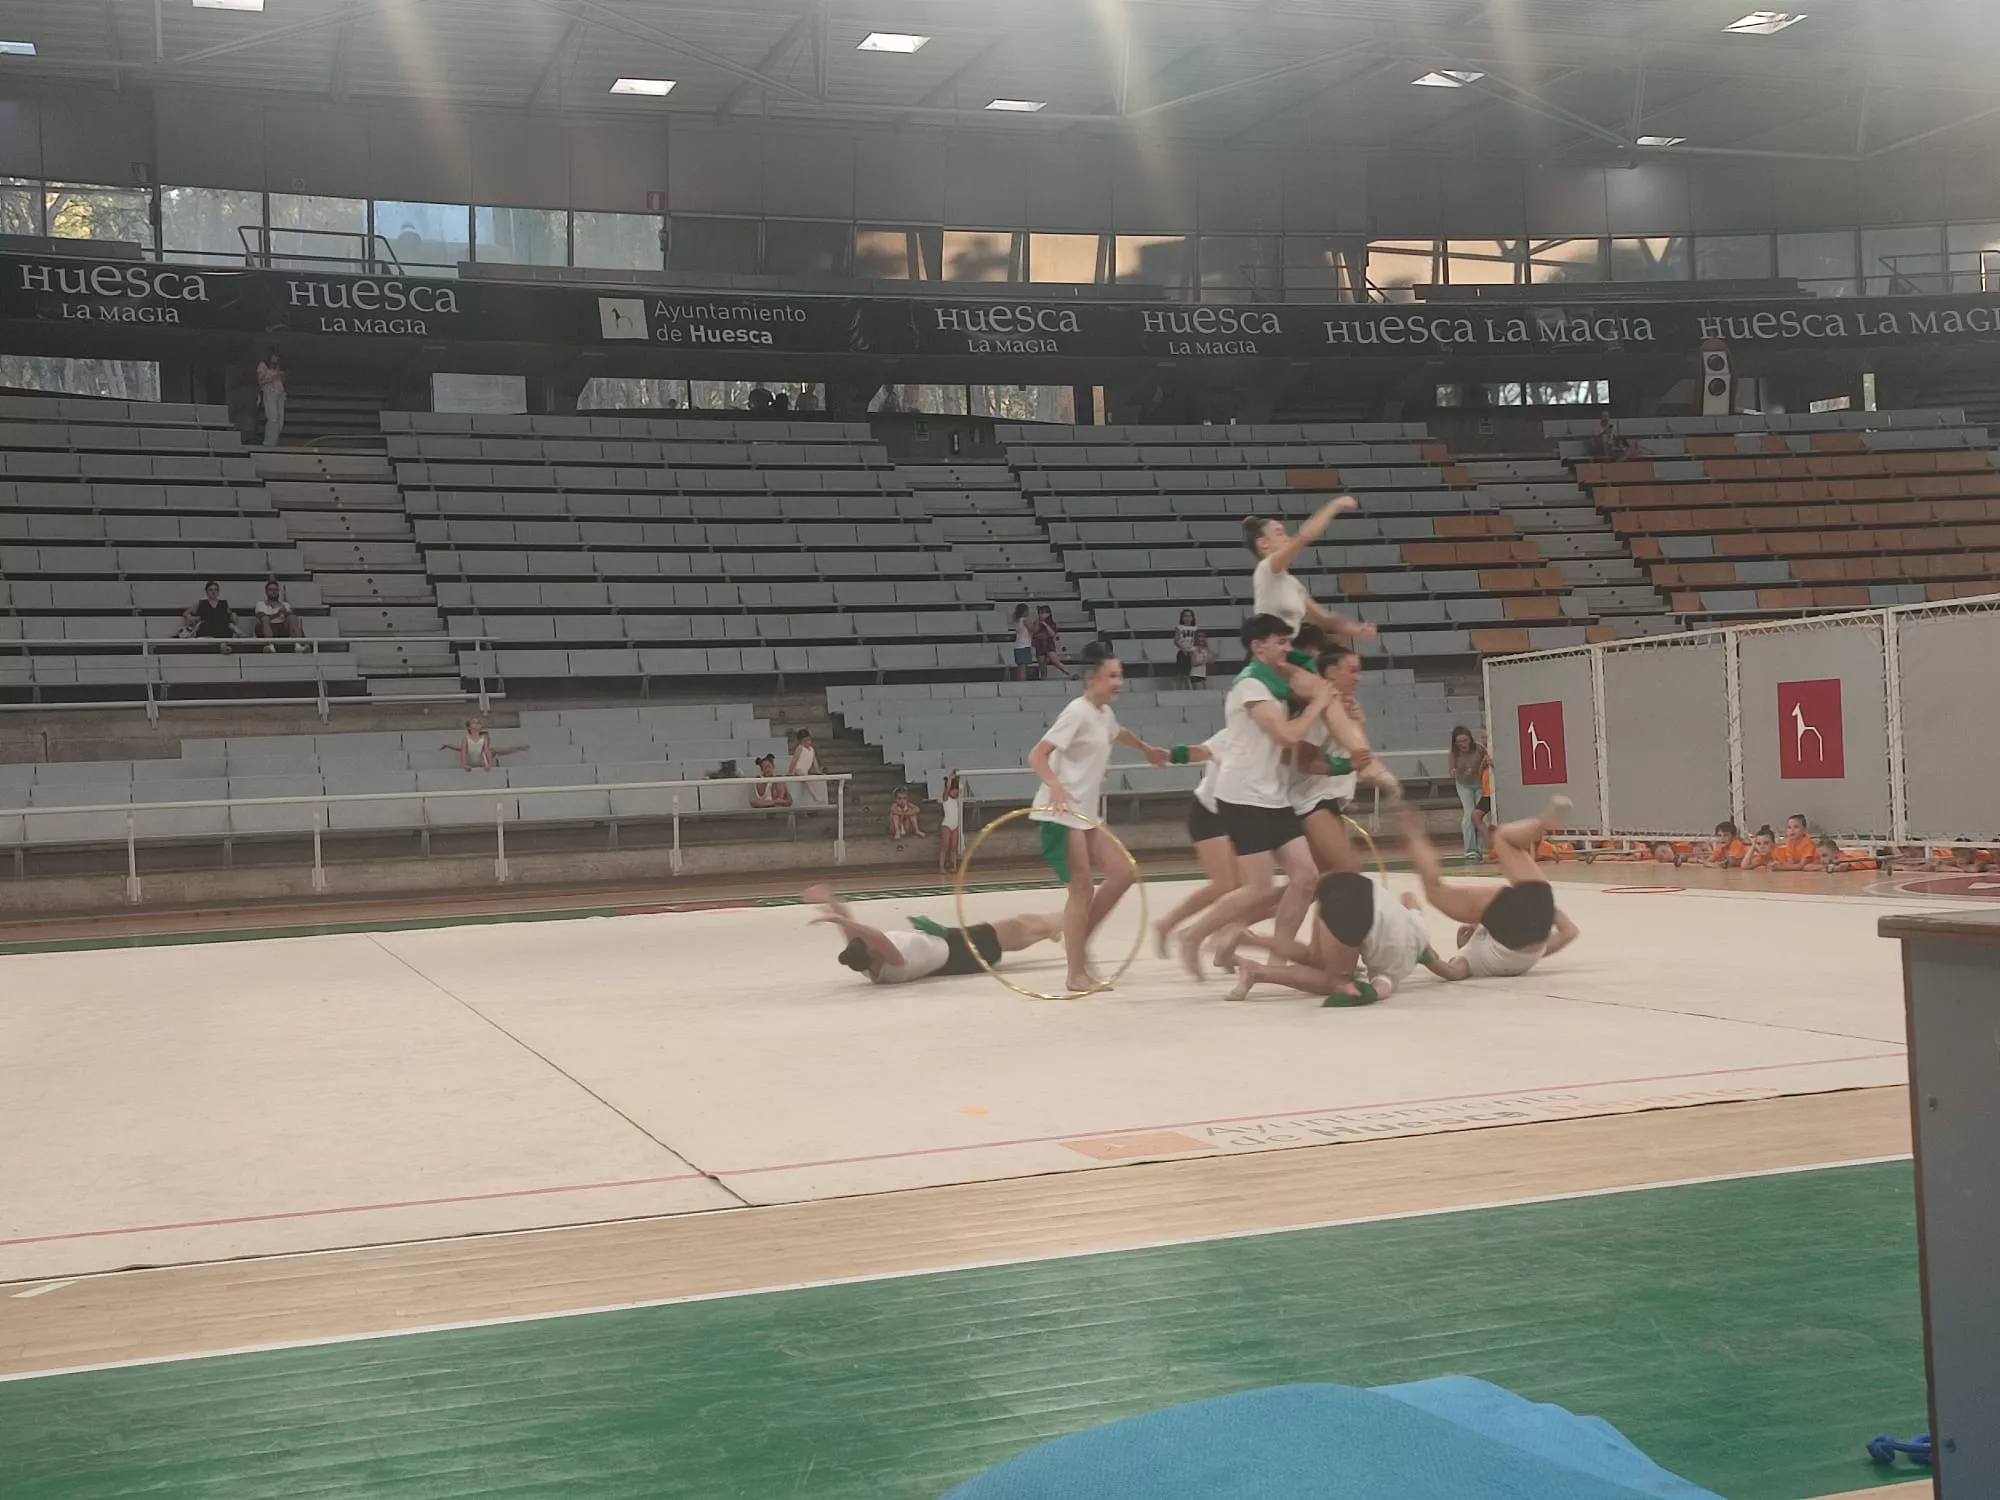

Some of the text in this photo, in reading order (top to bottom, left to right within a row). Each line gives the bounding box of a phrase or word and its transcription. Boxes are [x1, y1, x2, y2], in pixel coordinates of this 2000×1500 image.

[655, 300, 807, 324] Ayuntamiento
[656, 324, 773, 345] de Huesca
[1206, 1093, 1579, 1137] Ayuntamiento
[1230, 1134, 1302, 1147] de
[1307, 1111, 1530, 1138] Huesca
